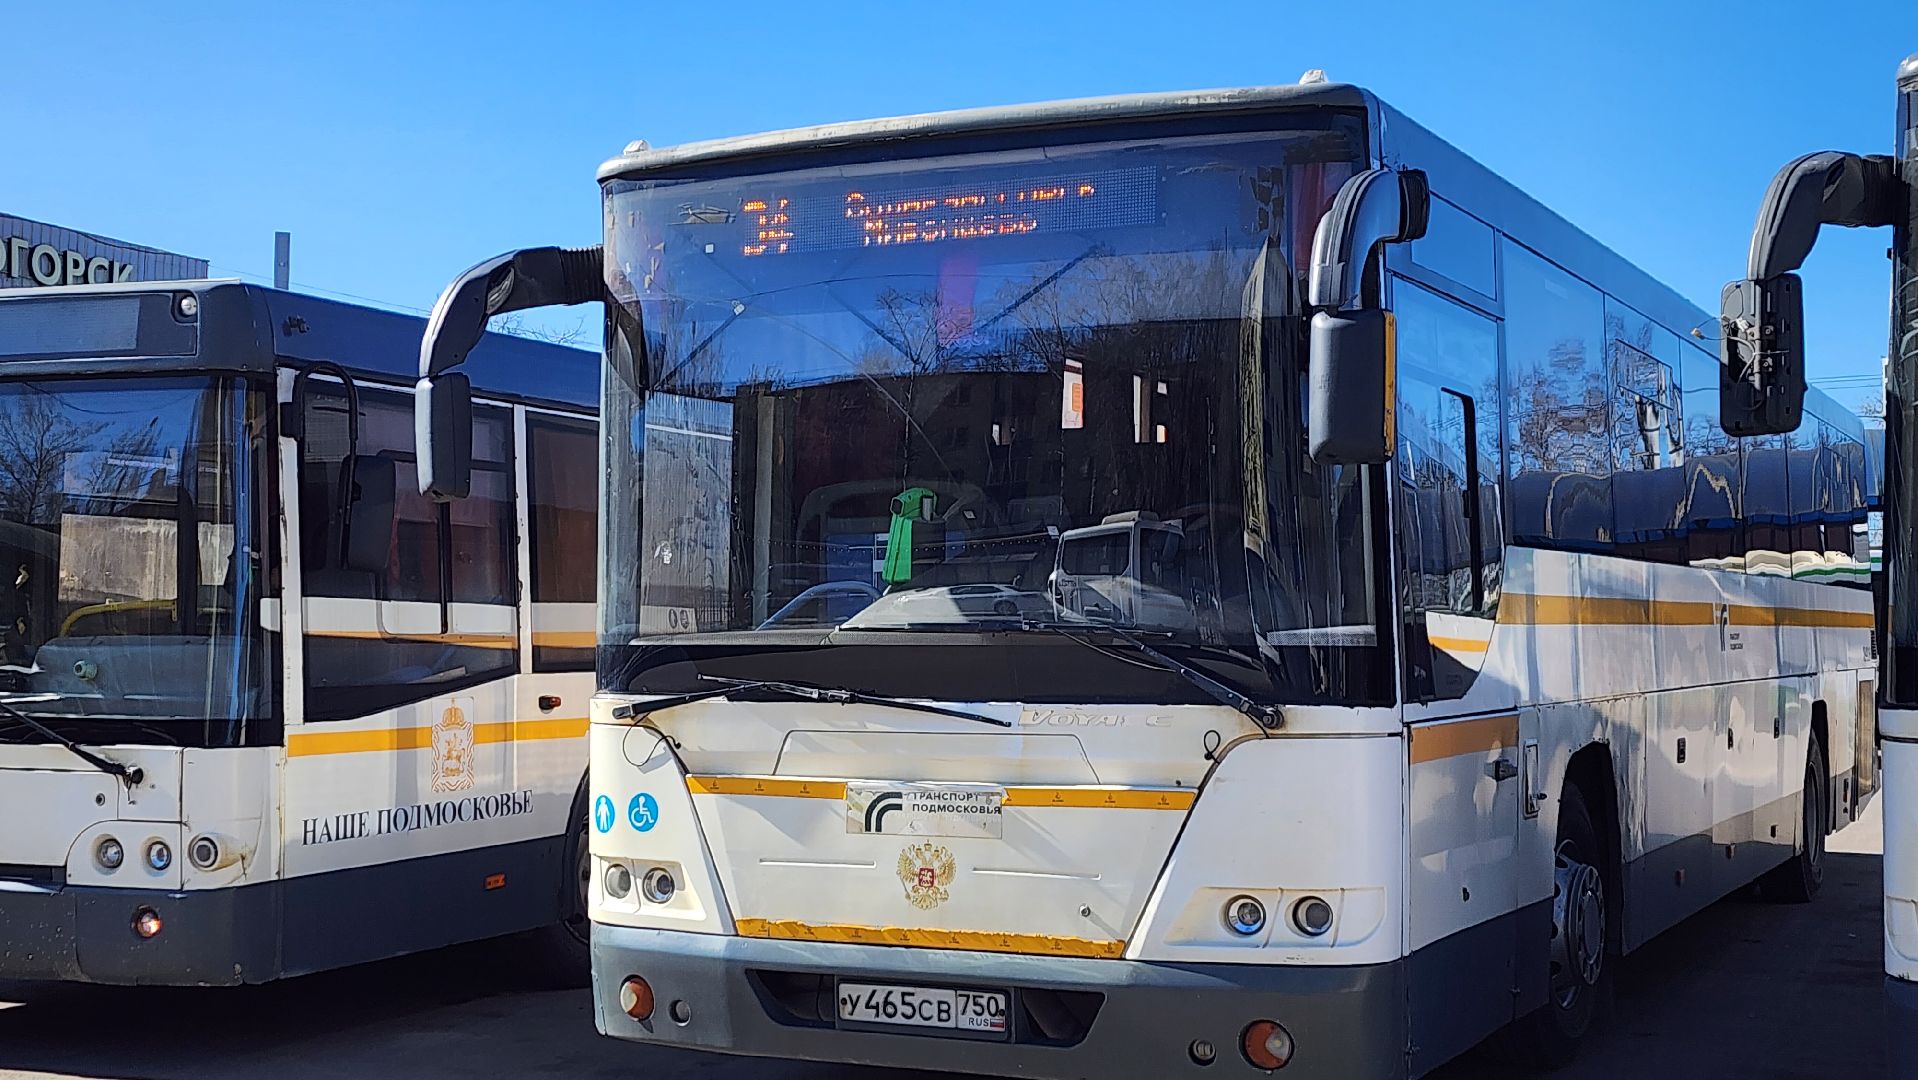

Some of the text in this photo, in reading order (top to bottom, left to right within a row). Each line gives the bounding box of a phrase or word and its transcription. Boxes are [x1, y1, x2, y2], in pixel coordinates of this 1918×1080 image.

[0, 236, 134, 286] ГОРСК
[302, 789, 534, 846] НАШЕ ПОДМОСКОВЬЕ
[912, 803, 1001, 815] ПОДМОСКОВЬЯ
[957, 993, 1000, 1018] 750
[968, 1017, 990, 1028] RUS
